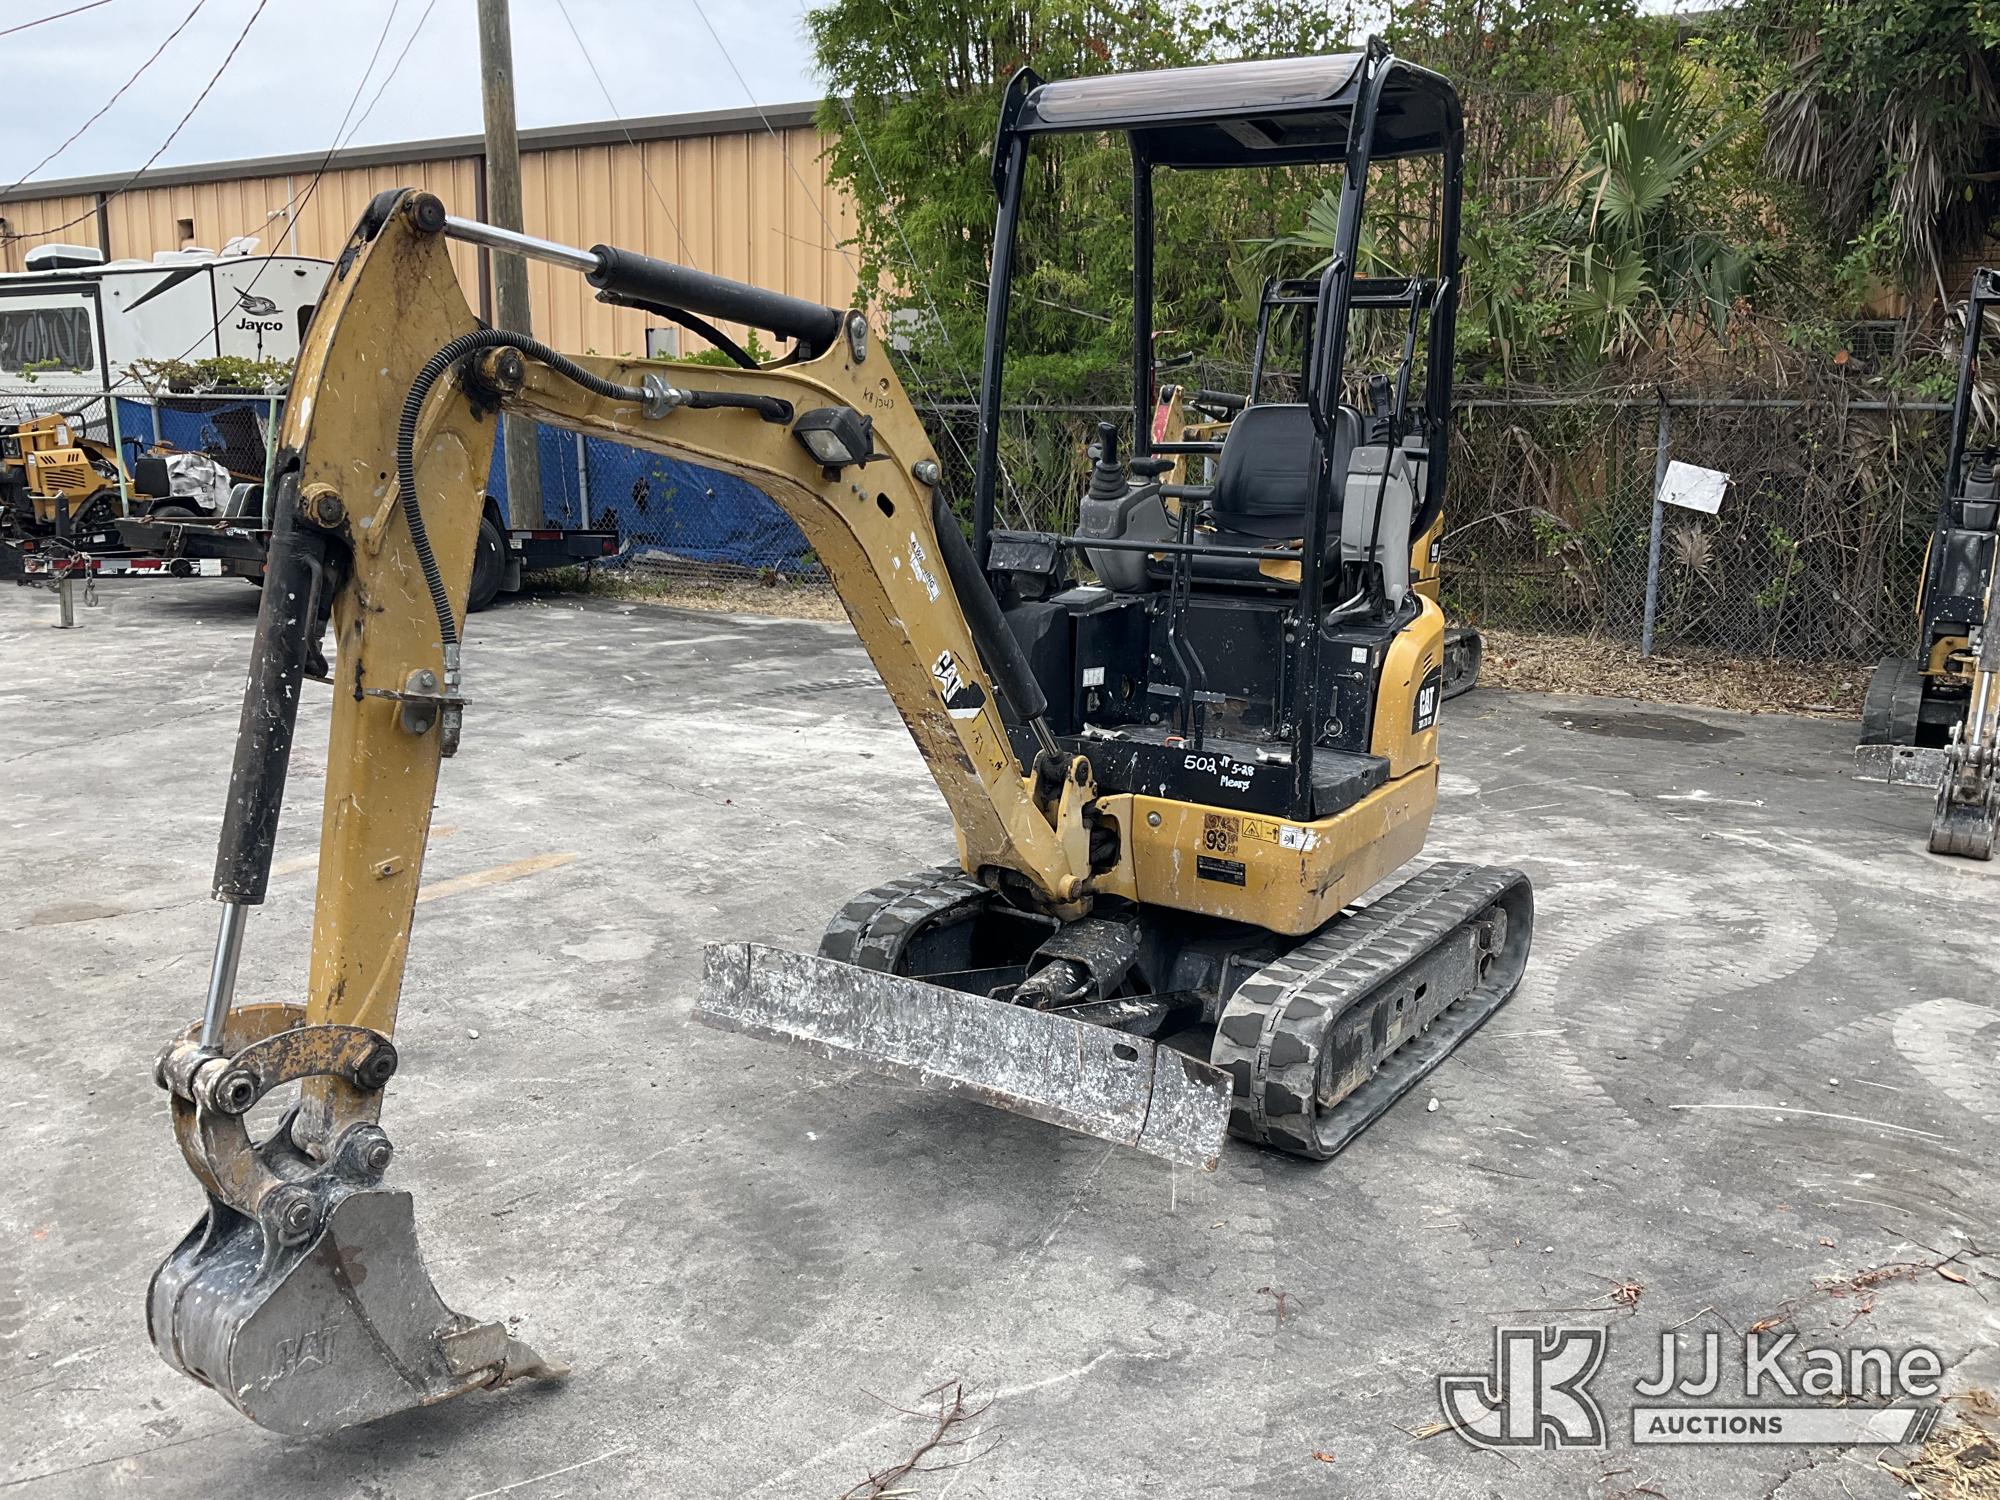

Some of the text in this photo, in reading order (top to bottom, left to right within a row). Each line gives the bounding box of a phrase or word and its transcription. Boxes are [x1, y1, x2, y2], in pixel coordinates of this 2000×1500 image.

[236, 318, 283, 332] Jayco
[1420, 686, 1434, 717] CAT
[1183, 754, 1217, 775] 502
[1206, 829, 1227, 852] 93
